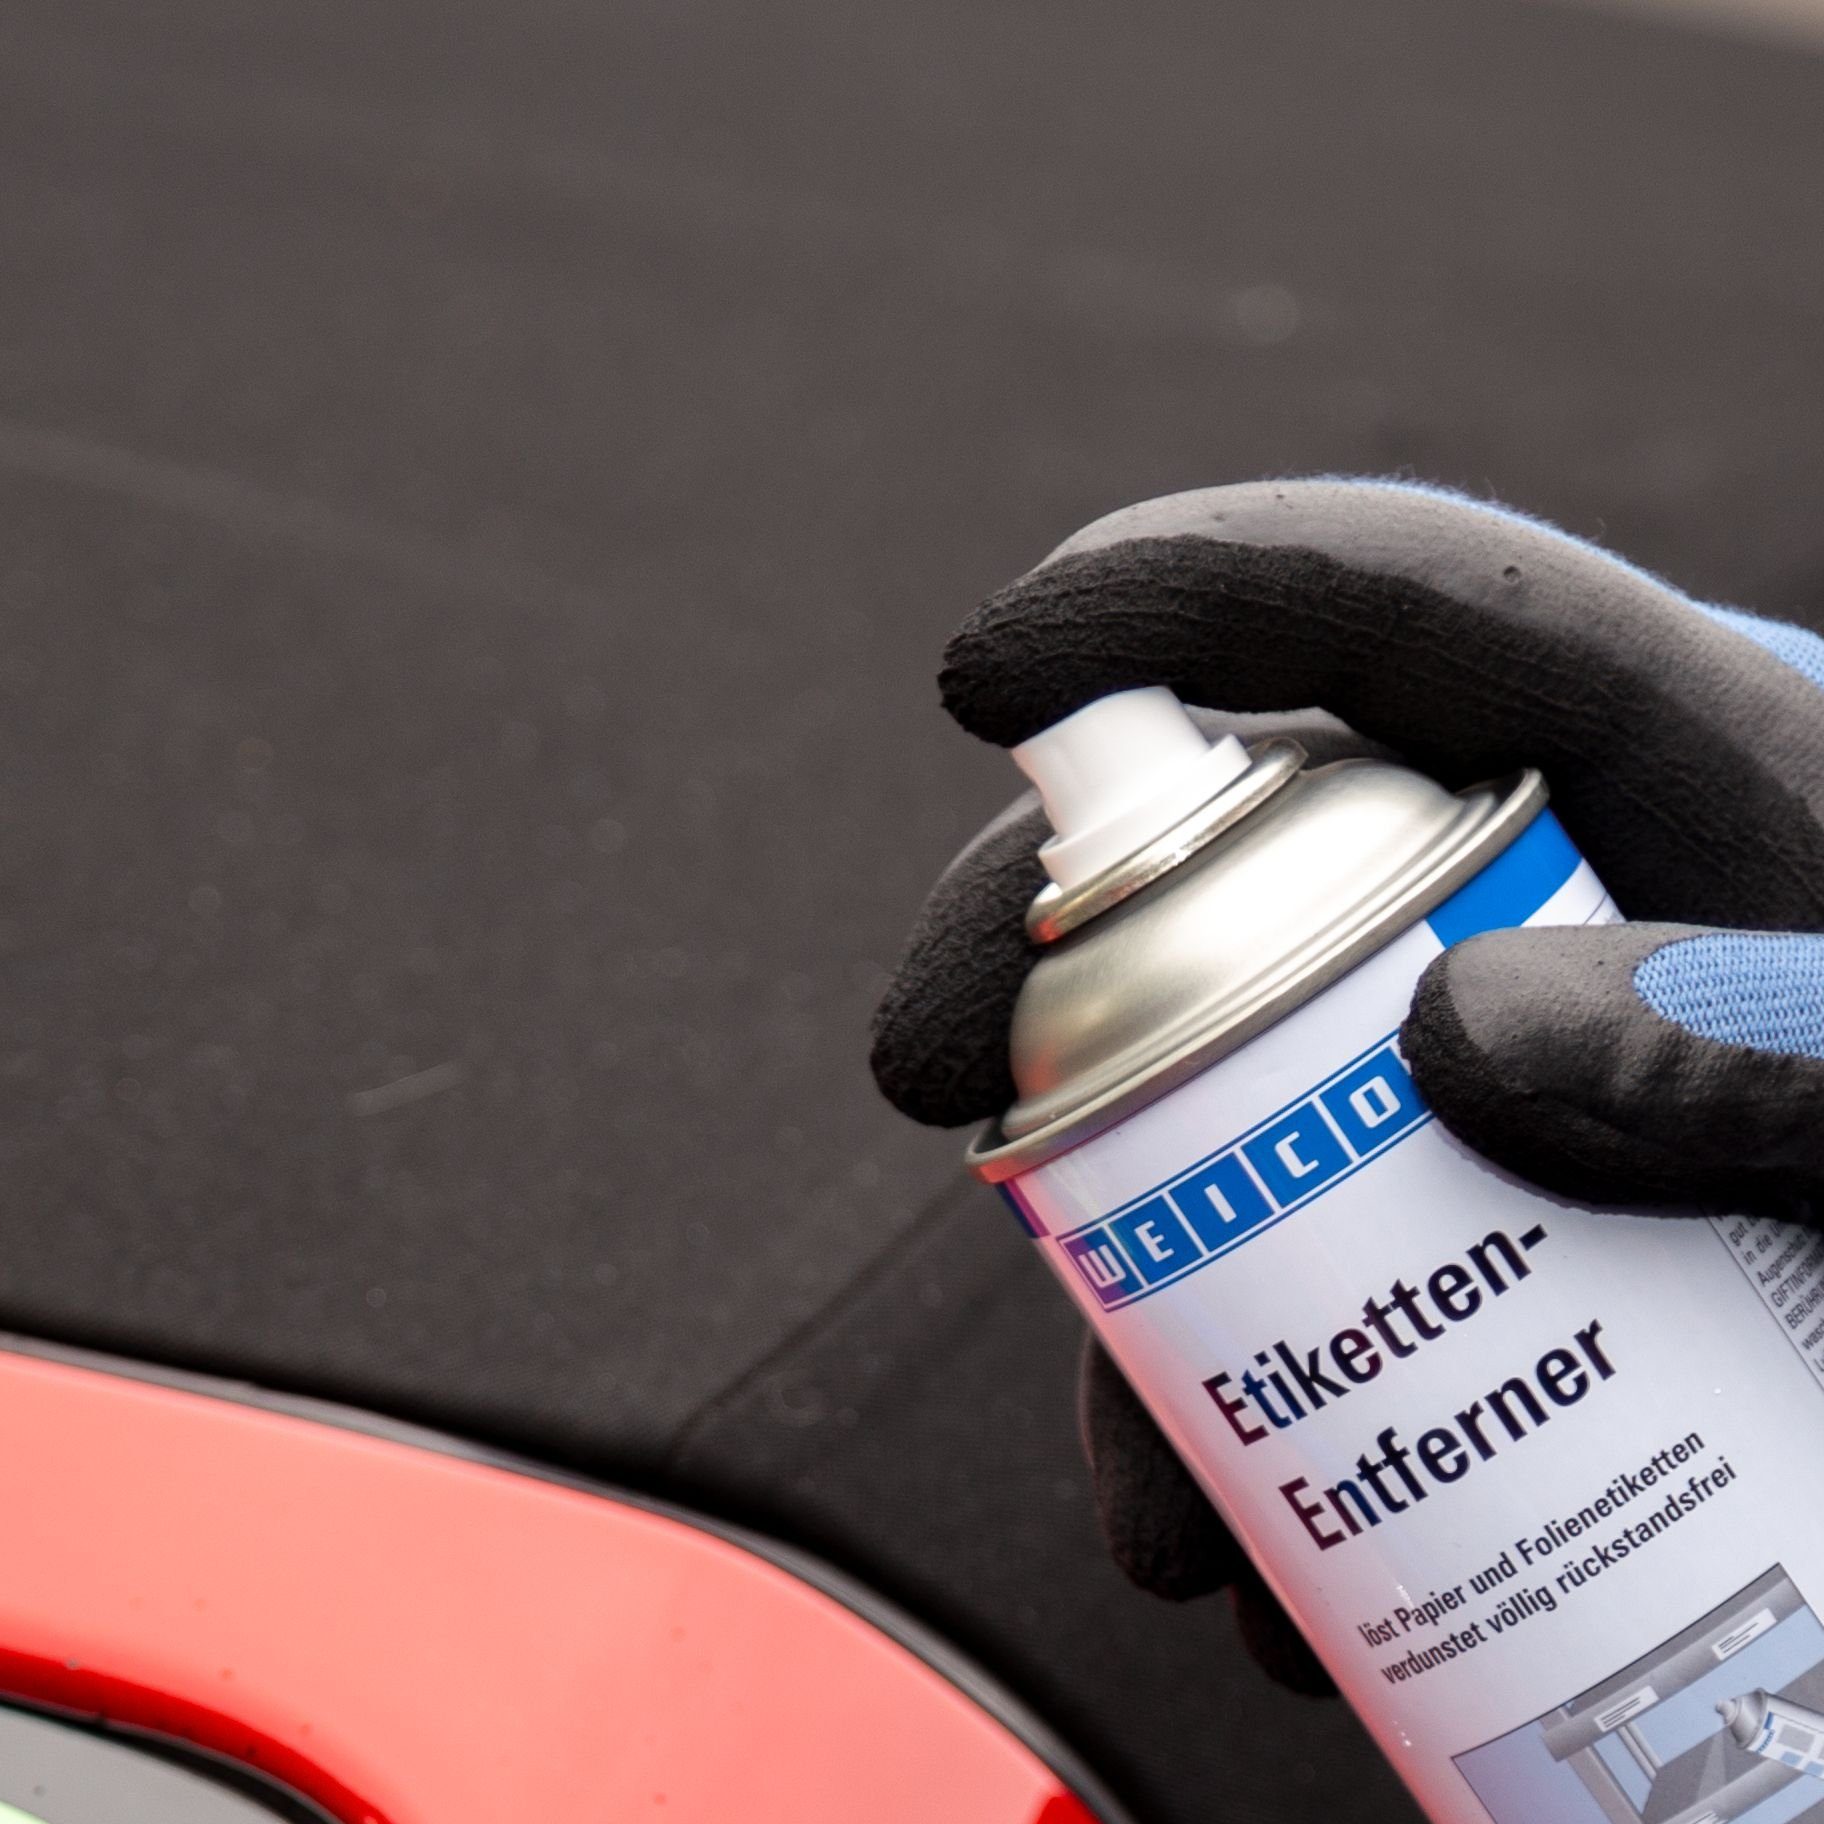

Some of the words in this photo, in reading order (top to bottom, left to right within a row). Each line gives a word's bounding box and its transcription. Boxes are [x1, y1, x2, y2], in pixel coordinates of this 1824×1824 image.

[1078, 1076, 1401, 1289] WEICO
[1202, 1223, 1548, 1447] Etiketten-
[1279, 1318, 1616, 1551] Entferner
[1358, 1617, 1401, 1649] löst
[1394, 1585, 1468, 1633] Papier
[1469, 1551, 1518, 1595] und
[1514, 1432, 1706, 1567] Folienetiketten
[1381, 1621, 1489, 1685] verdunstet
[1486, 1587, 1558, 1634] völlig
[1556, 1456, 1738, 1595] rückstandsfrei
